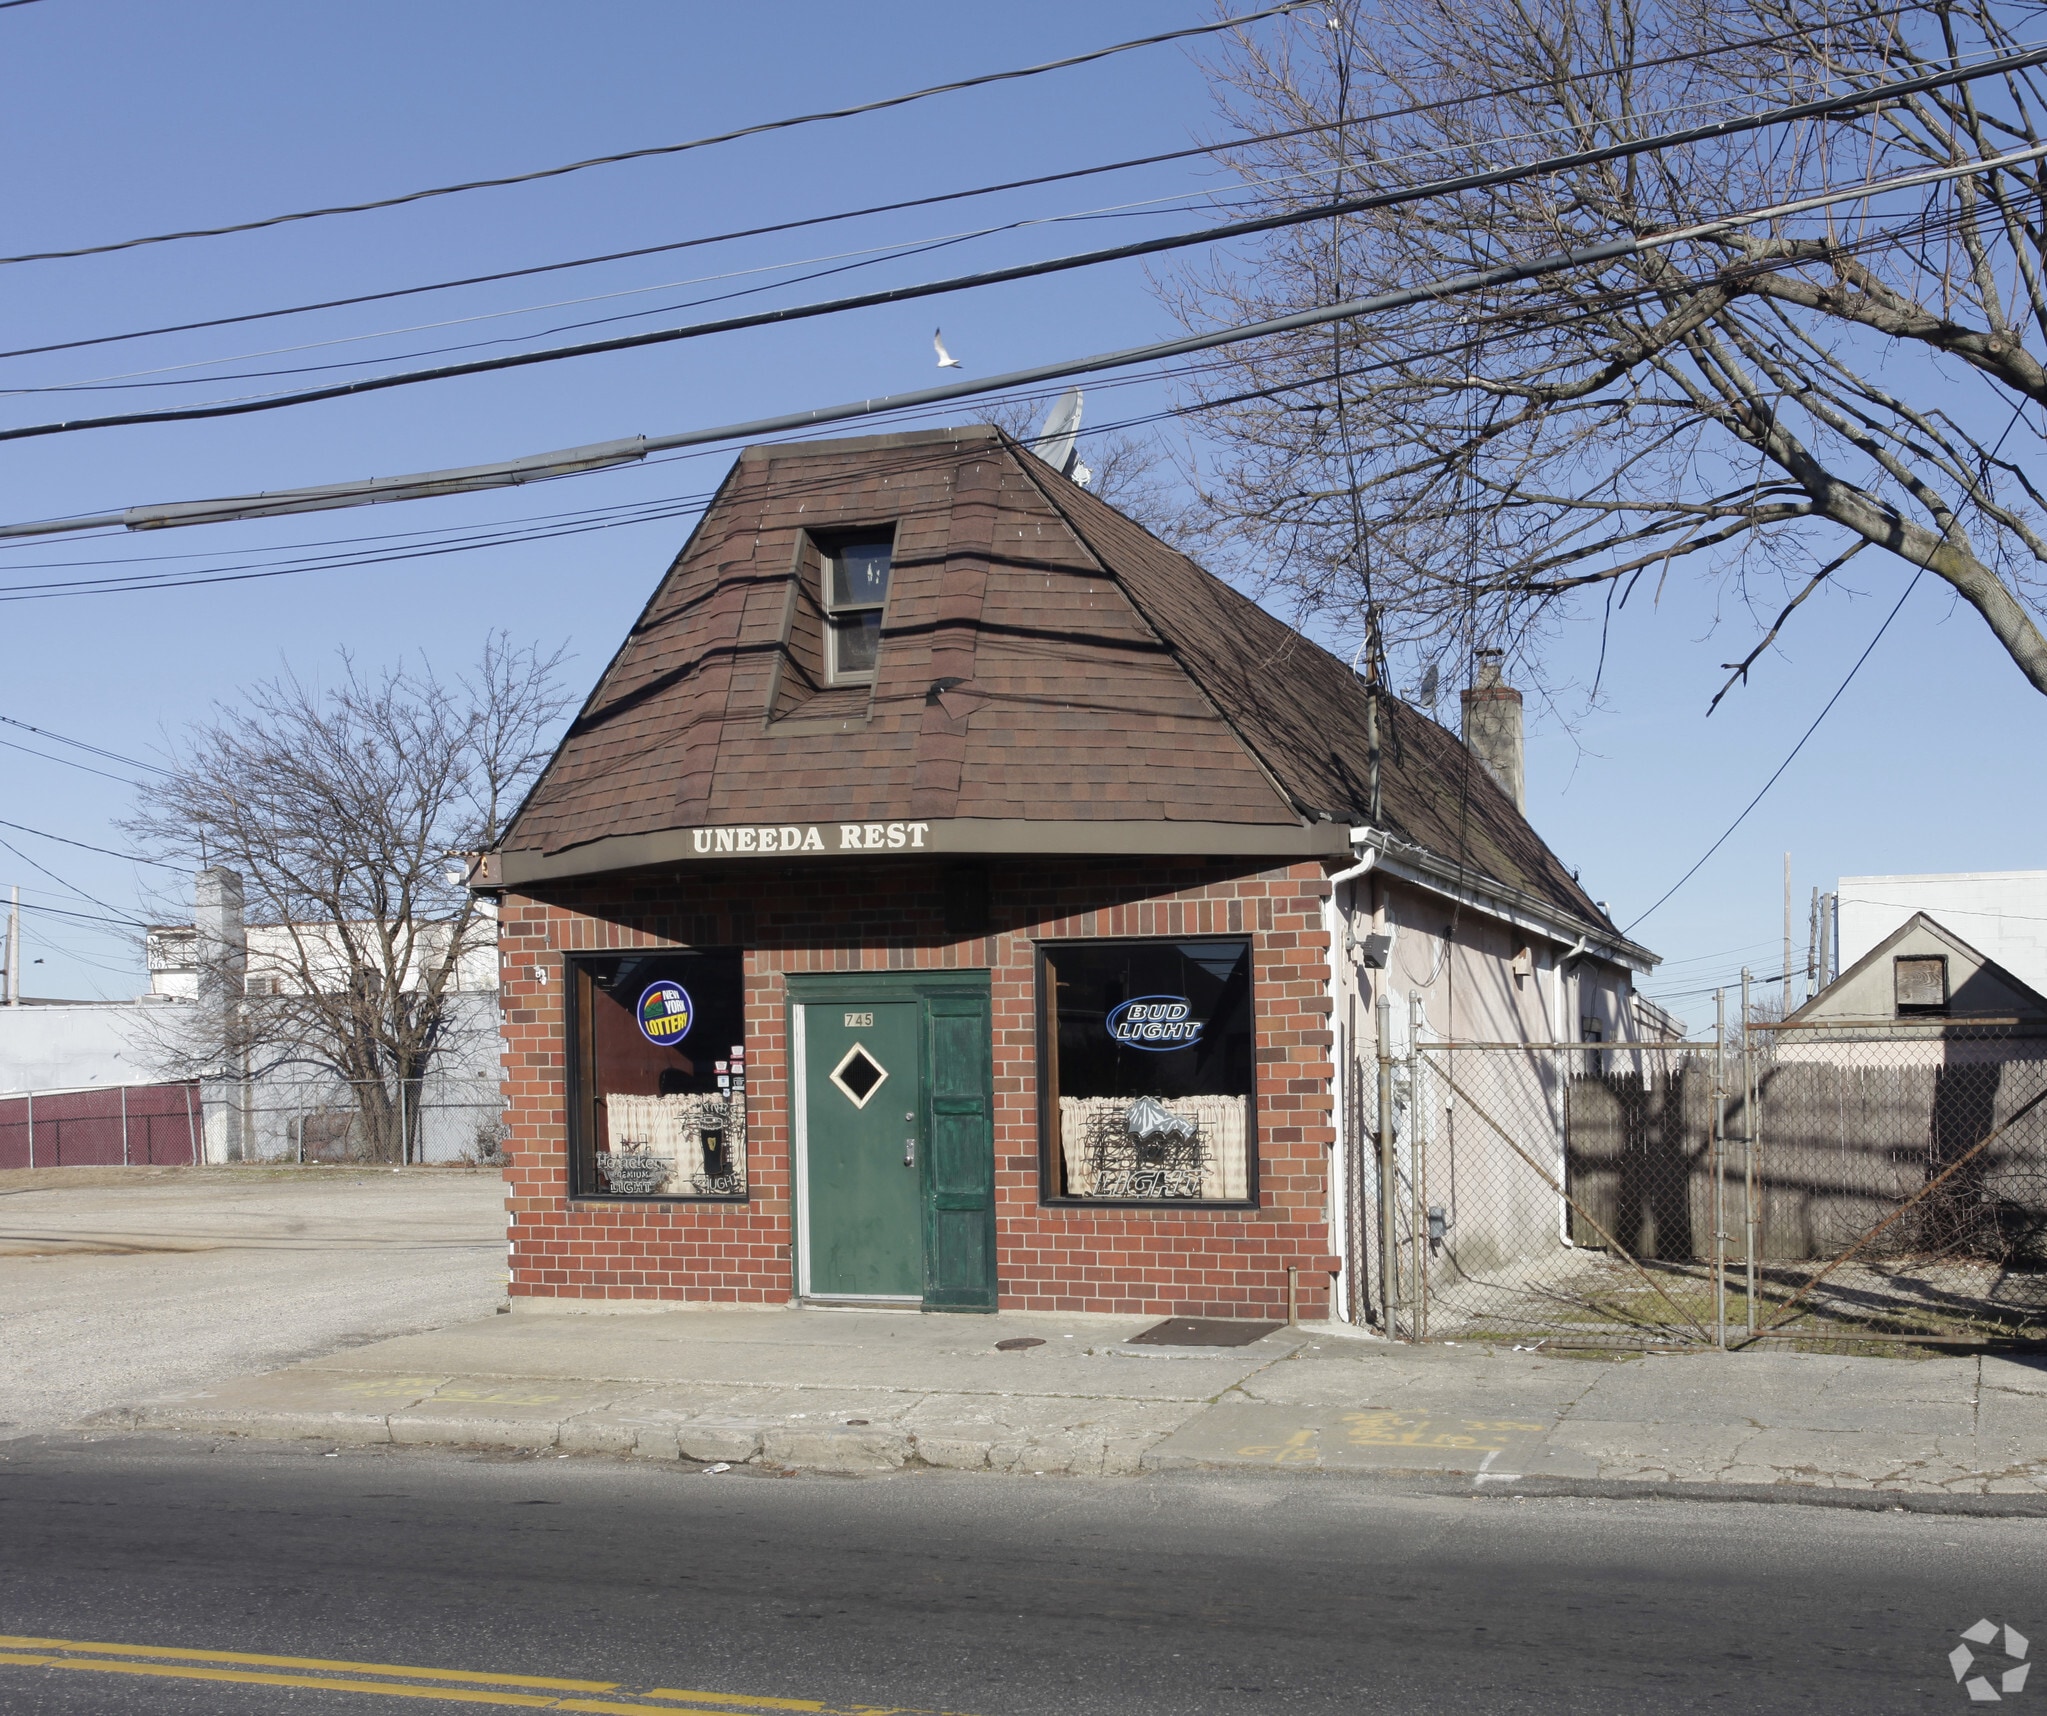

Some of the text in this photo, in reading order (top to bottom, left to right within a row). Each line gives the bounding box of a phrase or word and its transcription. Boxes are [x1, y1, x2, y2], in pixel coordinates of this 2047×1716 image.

[693, 823, 929, 853] UNEEDA REST
[662, 990, 680, 1000] NEW
[664, 1000, 686, 1014] YORK
[1127, 1004, 1188, 1022] BUD
[645, 1012, 688, 1036] LOTTERY
[846, 1013, 872, 1026] 745
[1116, 1022, 1202, 1040] LIGHT
[610, 1181, 652, 1193] LIGHT
[1093, 1170, 1207, 1195] LIGHT
